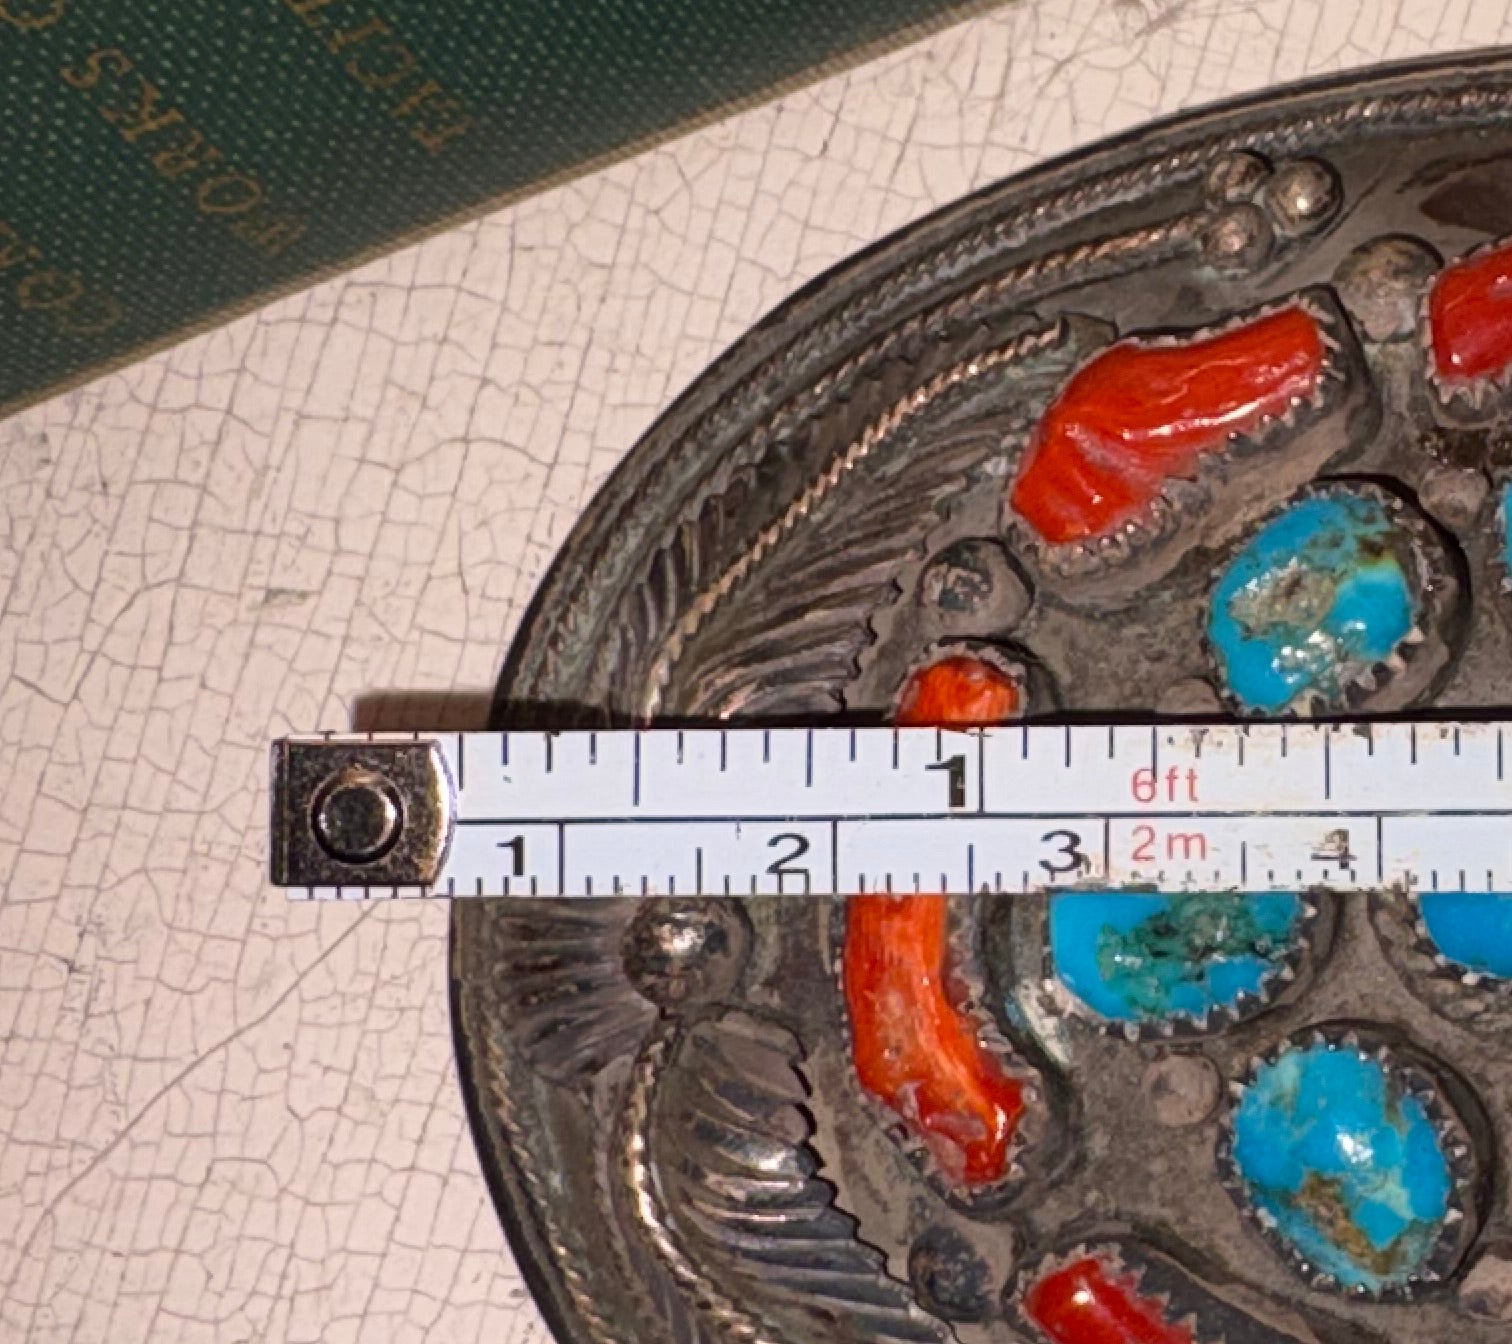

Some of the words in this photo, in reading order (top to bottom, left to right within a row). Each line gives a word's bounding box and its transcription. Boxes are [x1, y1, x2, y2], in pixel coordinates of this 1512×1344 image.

[60, 48, 308, 256] WORKS
[926, 754, 967, 807] 1
[1130, 764, 1201, 803] 6ft
[497, 836, 527, 877] 1
[766, 832, 811, 875] 2
[1037, 829, 1083, 874] 3
[1310, 829, 1356, 871] 4
[1130, 824, 1207, 862] 2m
